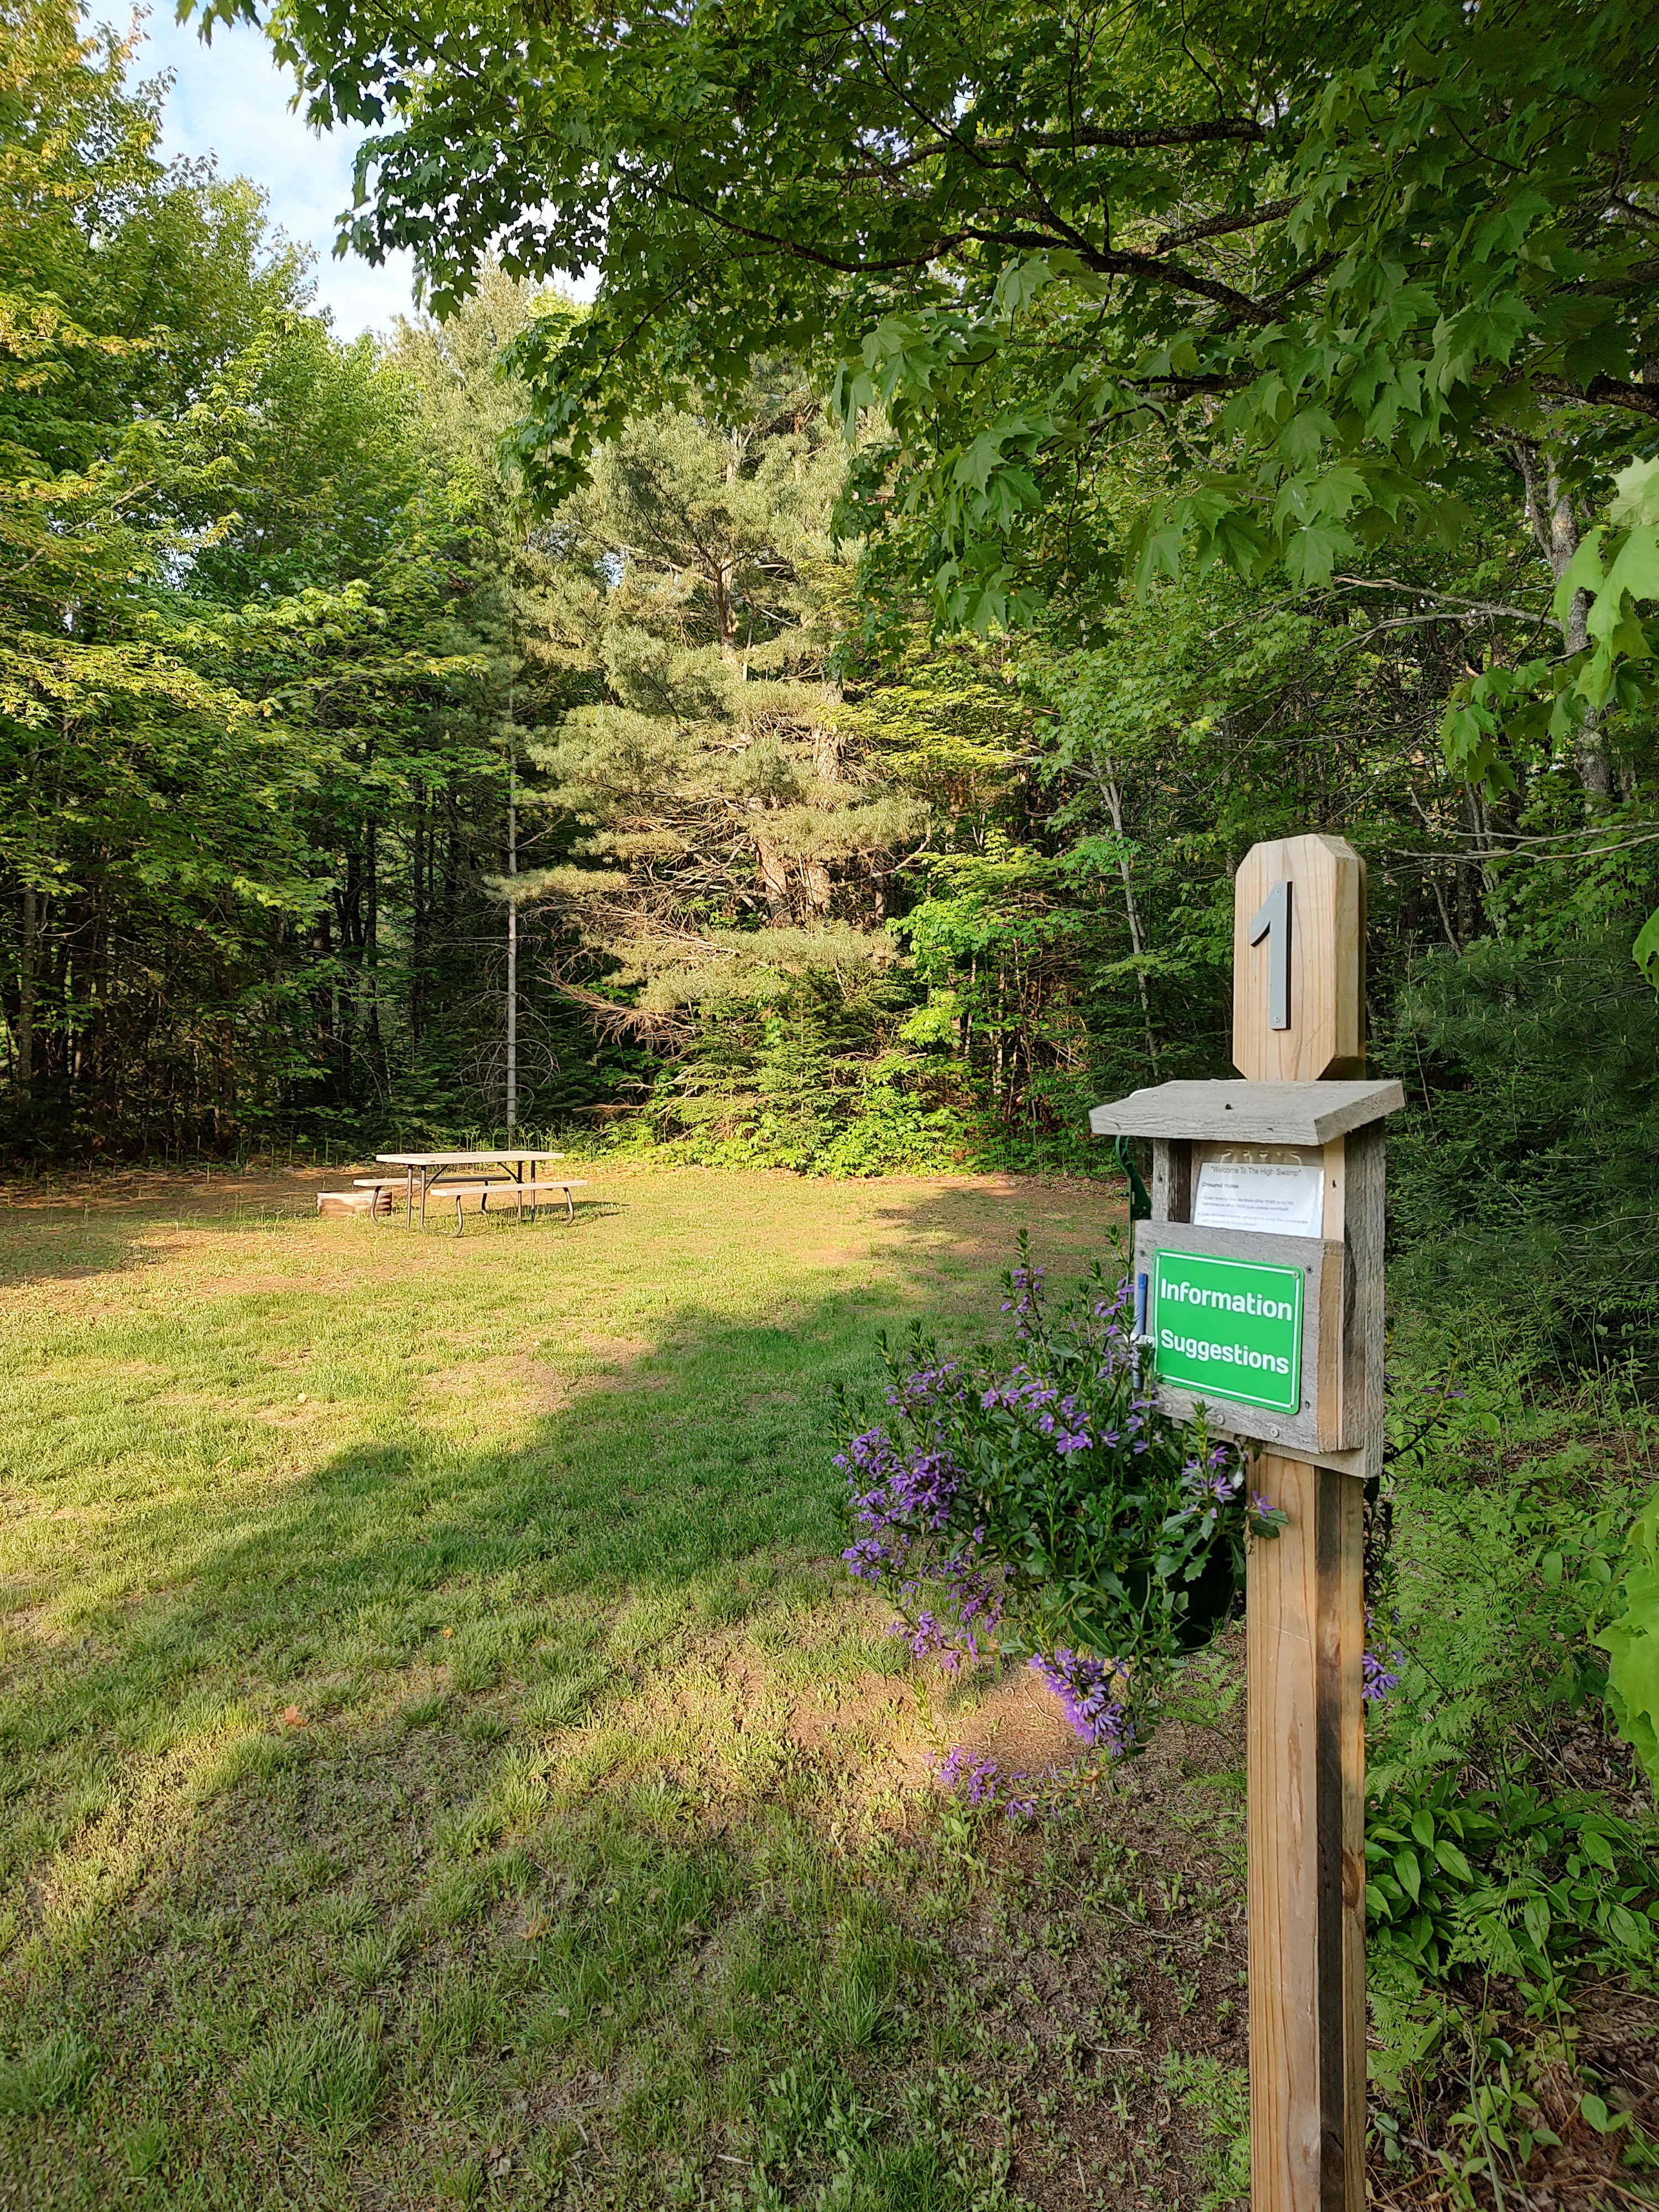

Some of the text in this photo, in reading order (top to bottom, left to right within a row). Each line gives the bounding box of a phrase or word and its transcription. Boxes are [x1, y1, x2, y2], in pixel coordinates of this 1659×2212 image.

[1249, 880, 1291, 1029] 1
[1261, 1168, 1274, 1176] High
[1161, 1278, 1292, 1321] Information
[1161, 1328, 1290, 1374] Suggestions
